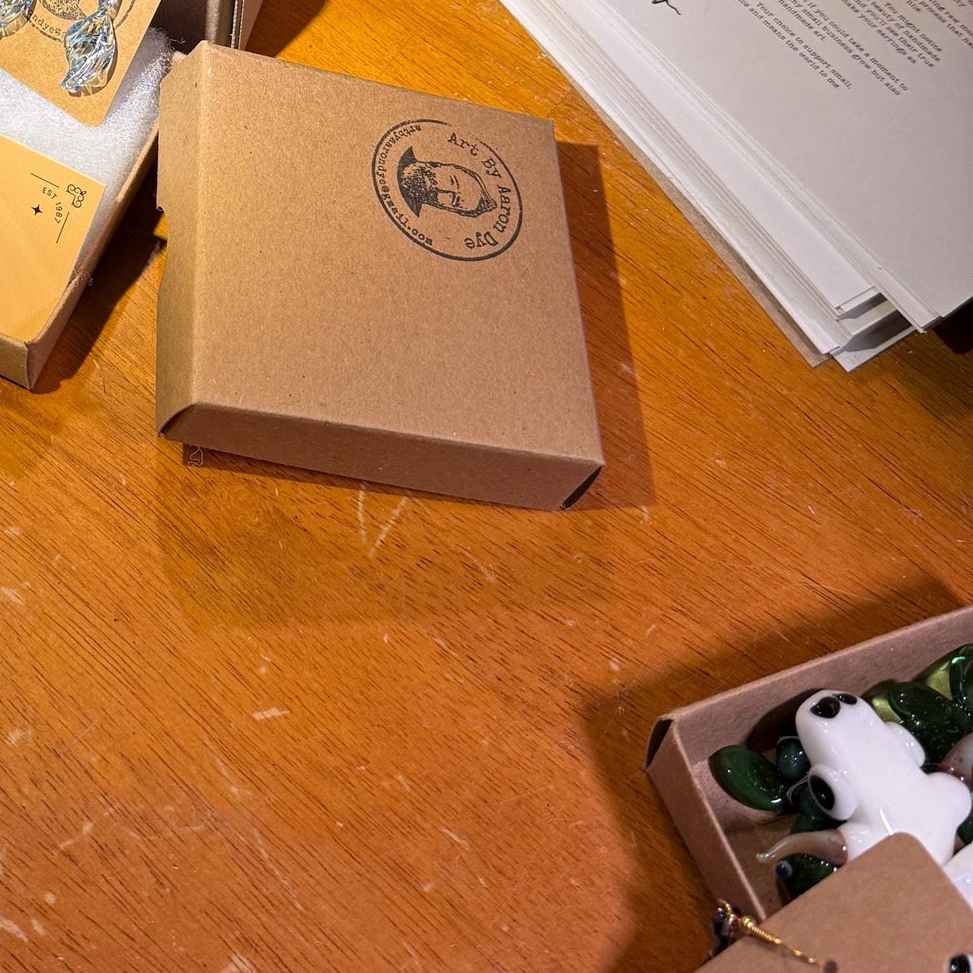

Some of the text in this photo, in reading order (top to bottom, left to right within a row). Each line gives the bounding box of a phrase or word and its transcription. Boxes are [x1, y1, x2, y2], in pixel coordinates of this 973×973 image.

[42, 187, 63, 224] EST 1987
[447, 132, 512, 250] Art By Aaron Dye
